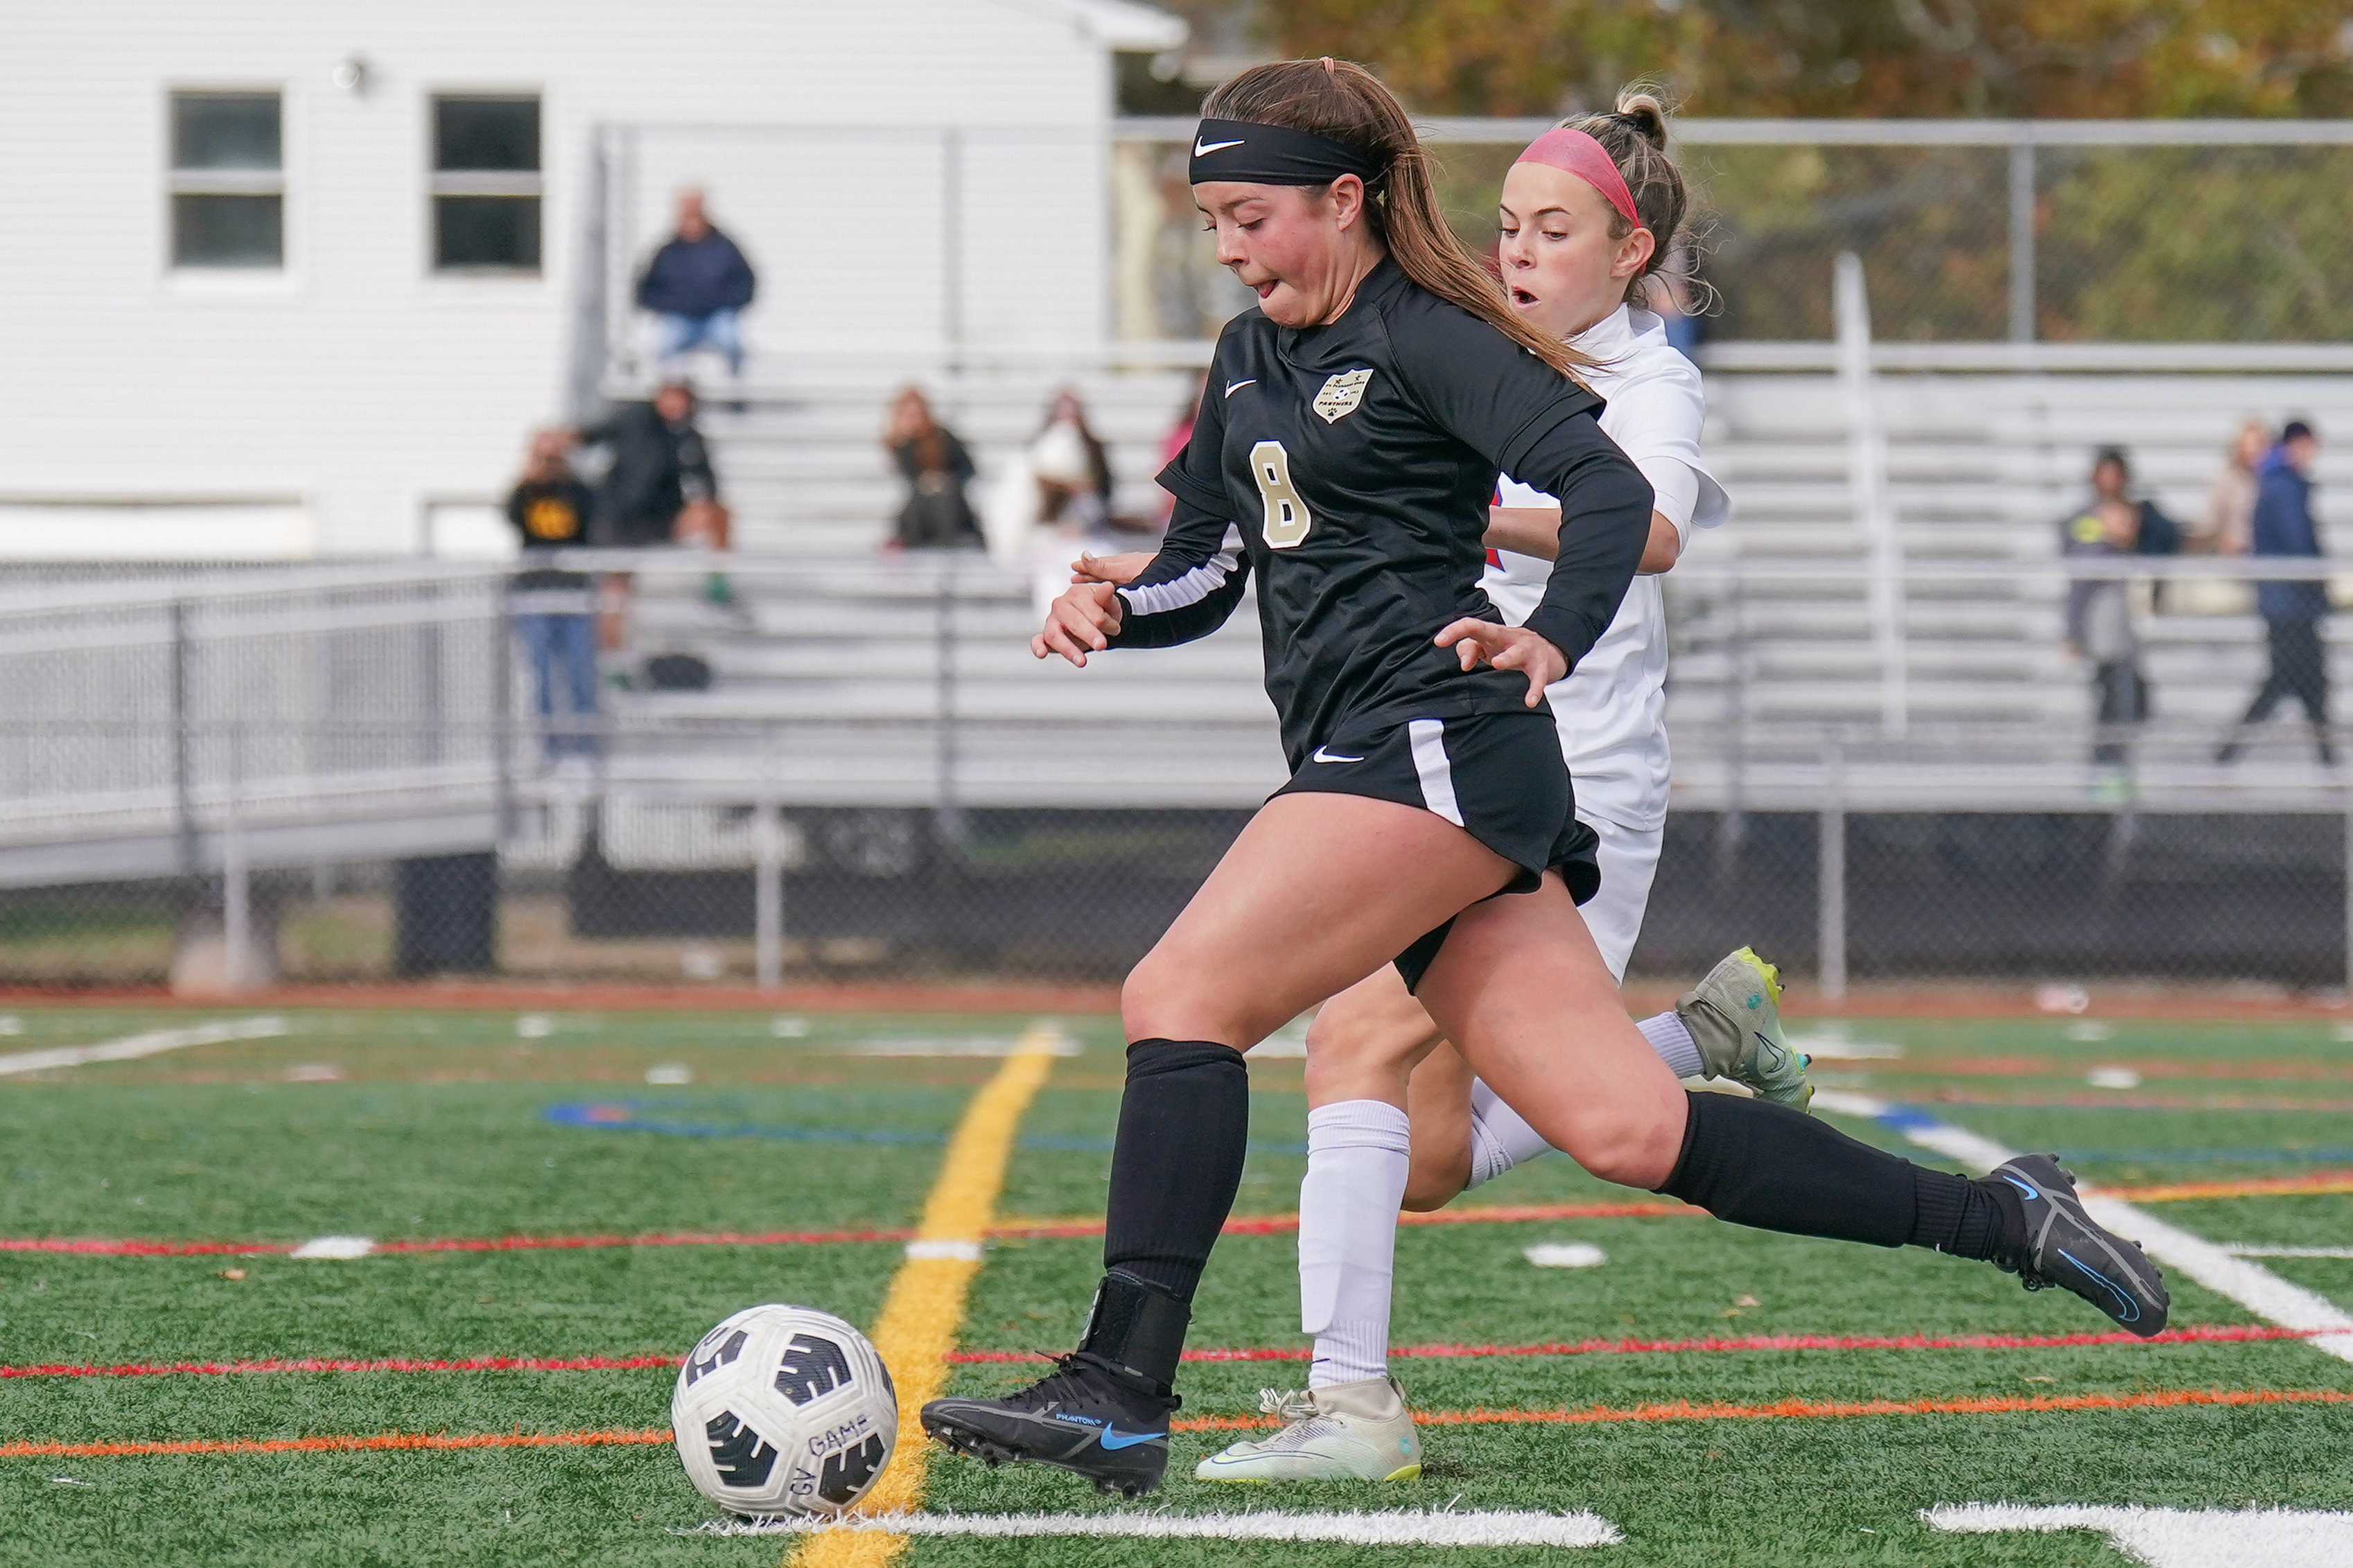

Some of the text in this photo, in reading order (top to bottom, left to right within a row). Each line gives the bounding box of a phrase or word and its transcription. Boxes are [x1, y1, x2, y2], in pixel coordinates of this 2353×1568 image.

[1250, 441, 1311, 549] 8
[809, 1413, 871, 1457] GAME
[1056, 1413, 1096, 1425] PHANTOM
